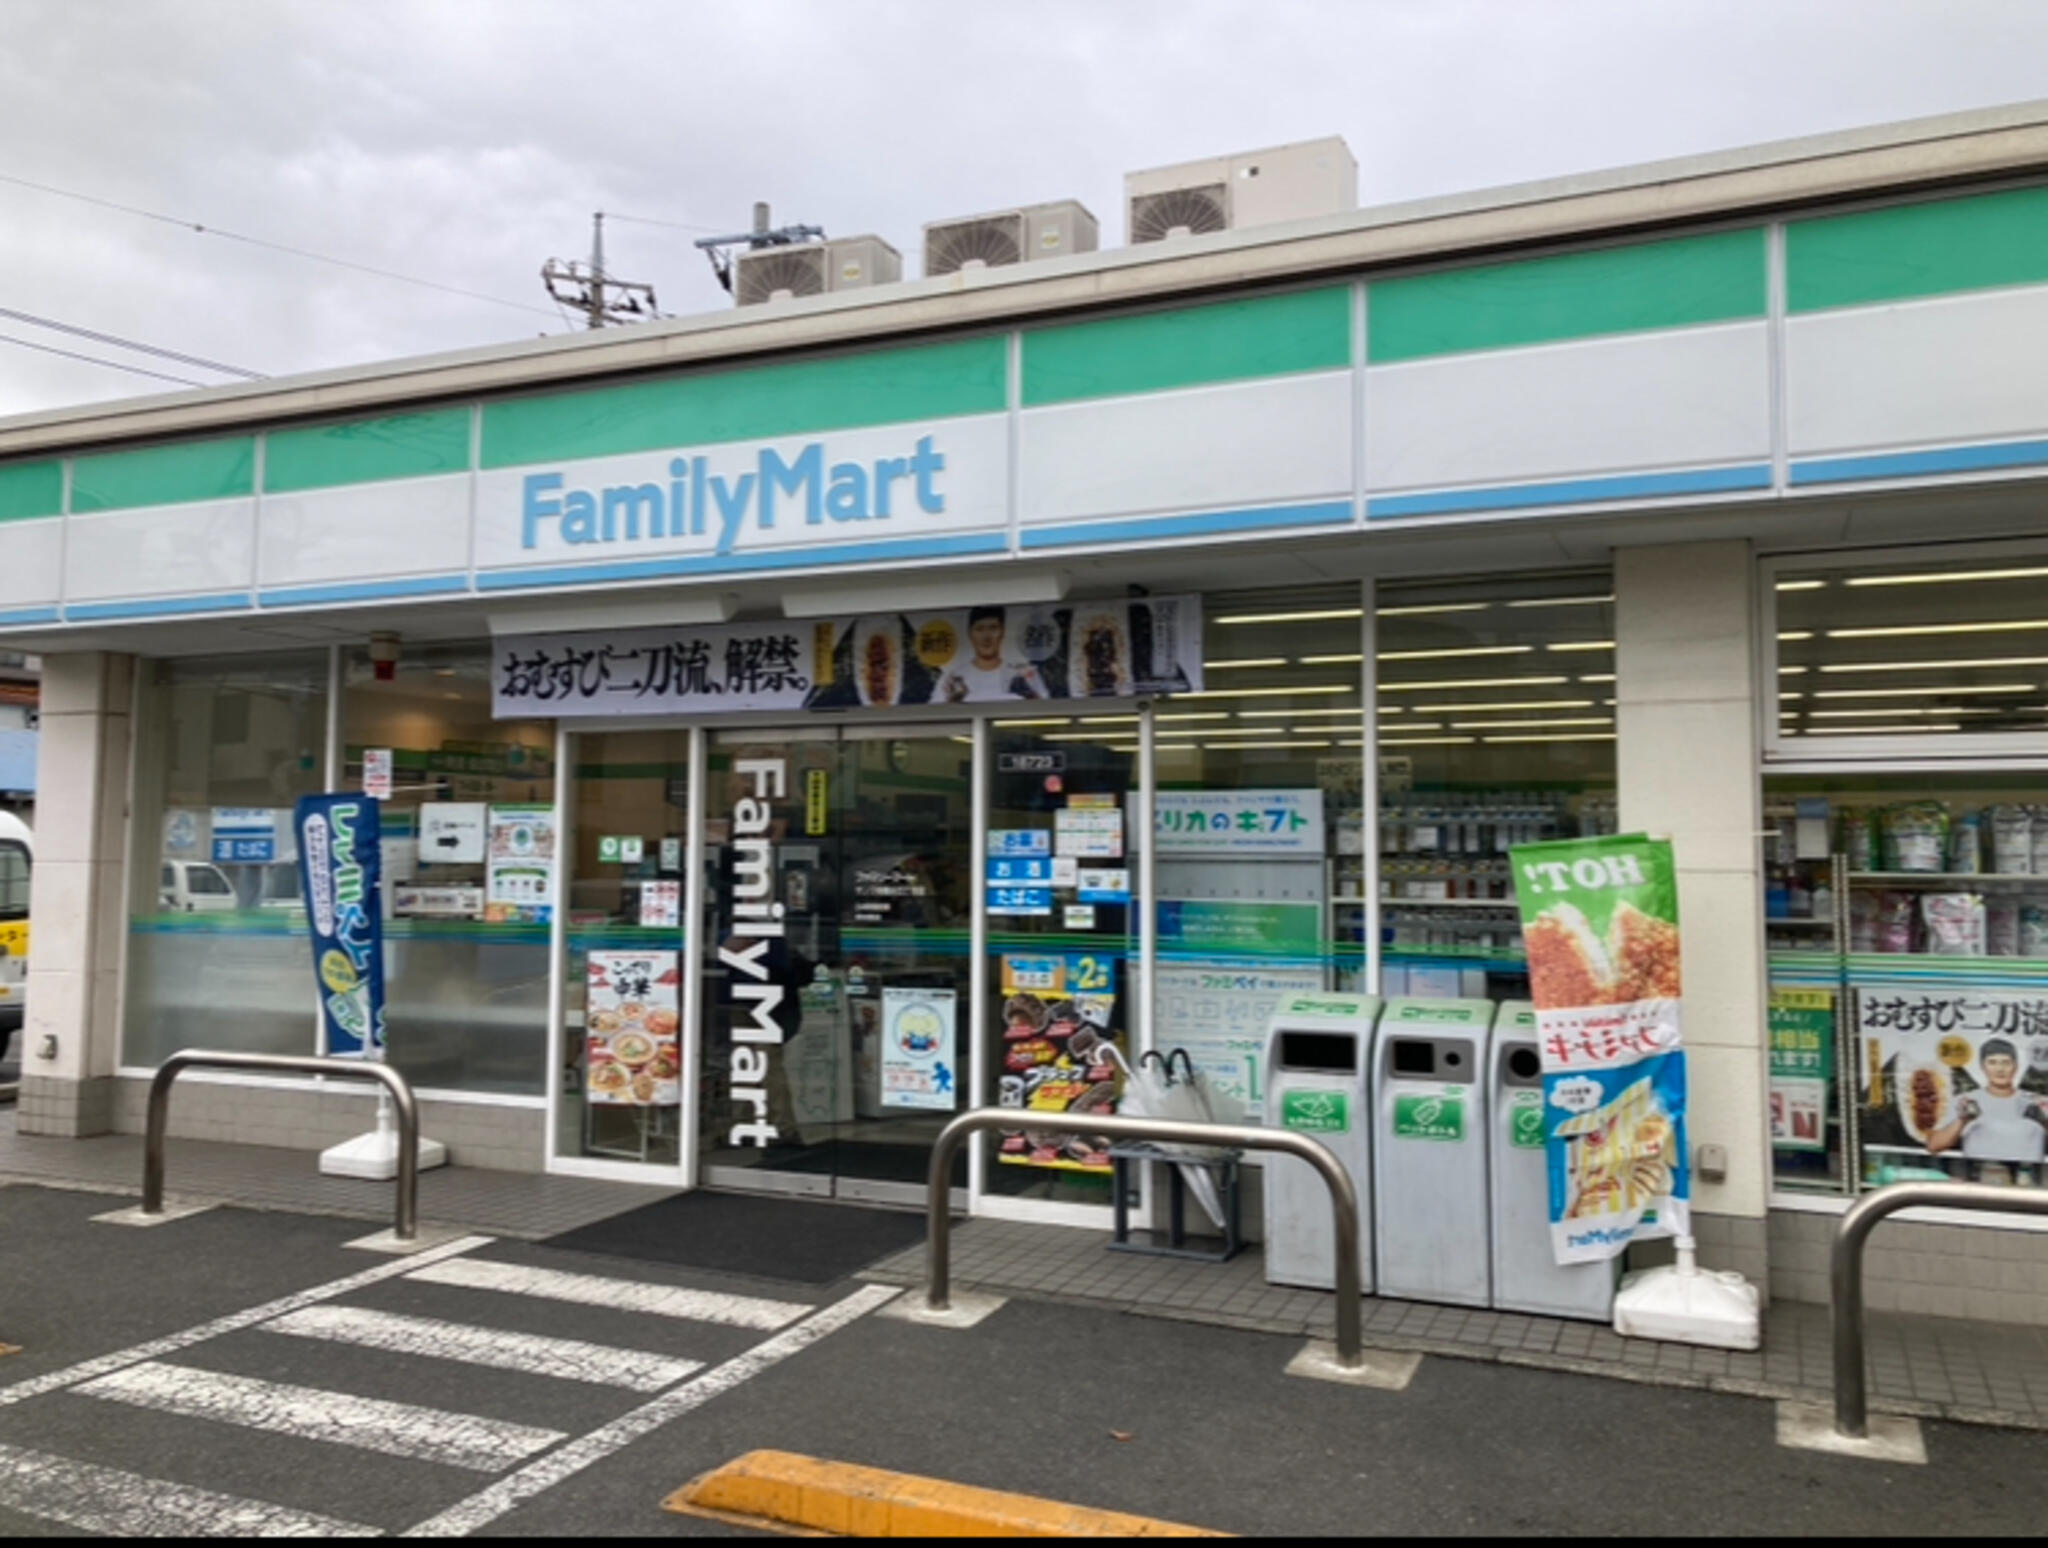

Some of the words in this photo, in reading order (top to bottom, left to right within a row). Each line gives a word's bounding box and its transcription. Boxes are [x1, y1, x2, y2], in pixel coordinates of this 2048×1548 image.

[522, 435, 945, 556] FamilyMart
[500, 635, 809, 700] おむすび二刀流、解禁。
[718, 758, 786, 1149] FamilyMart
